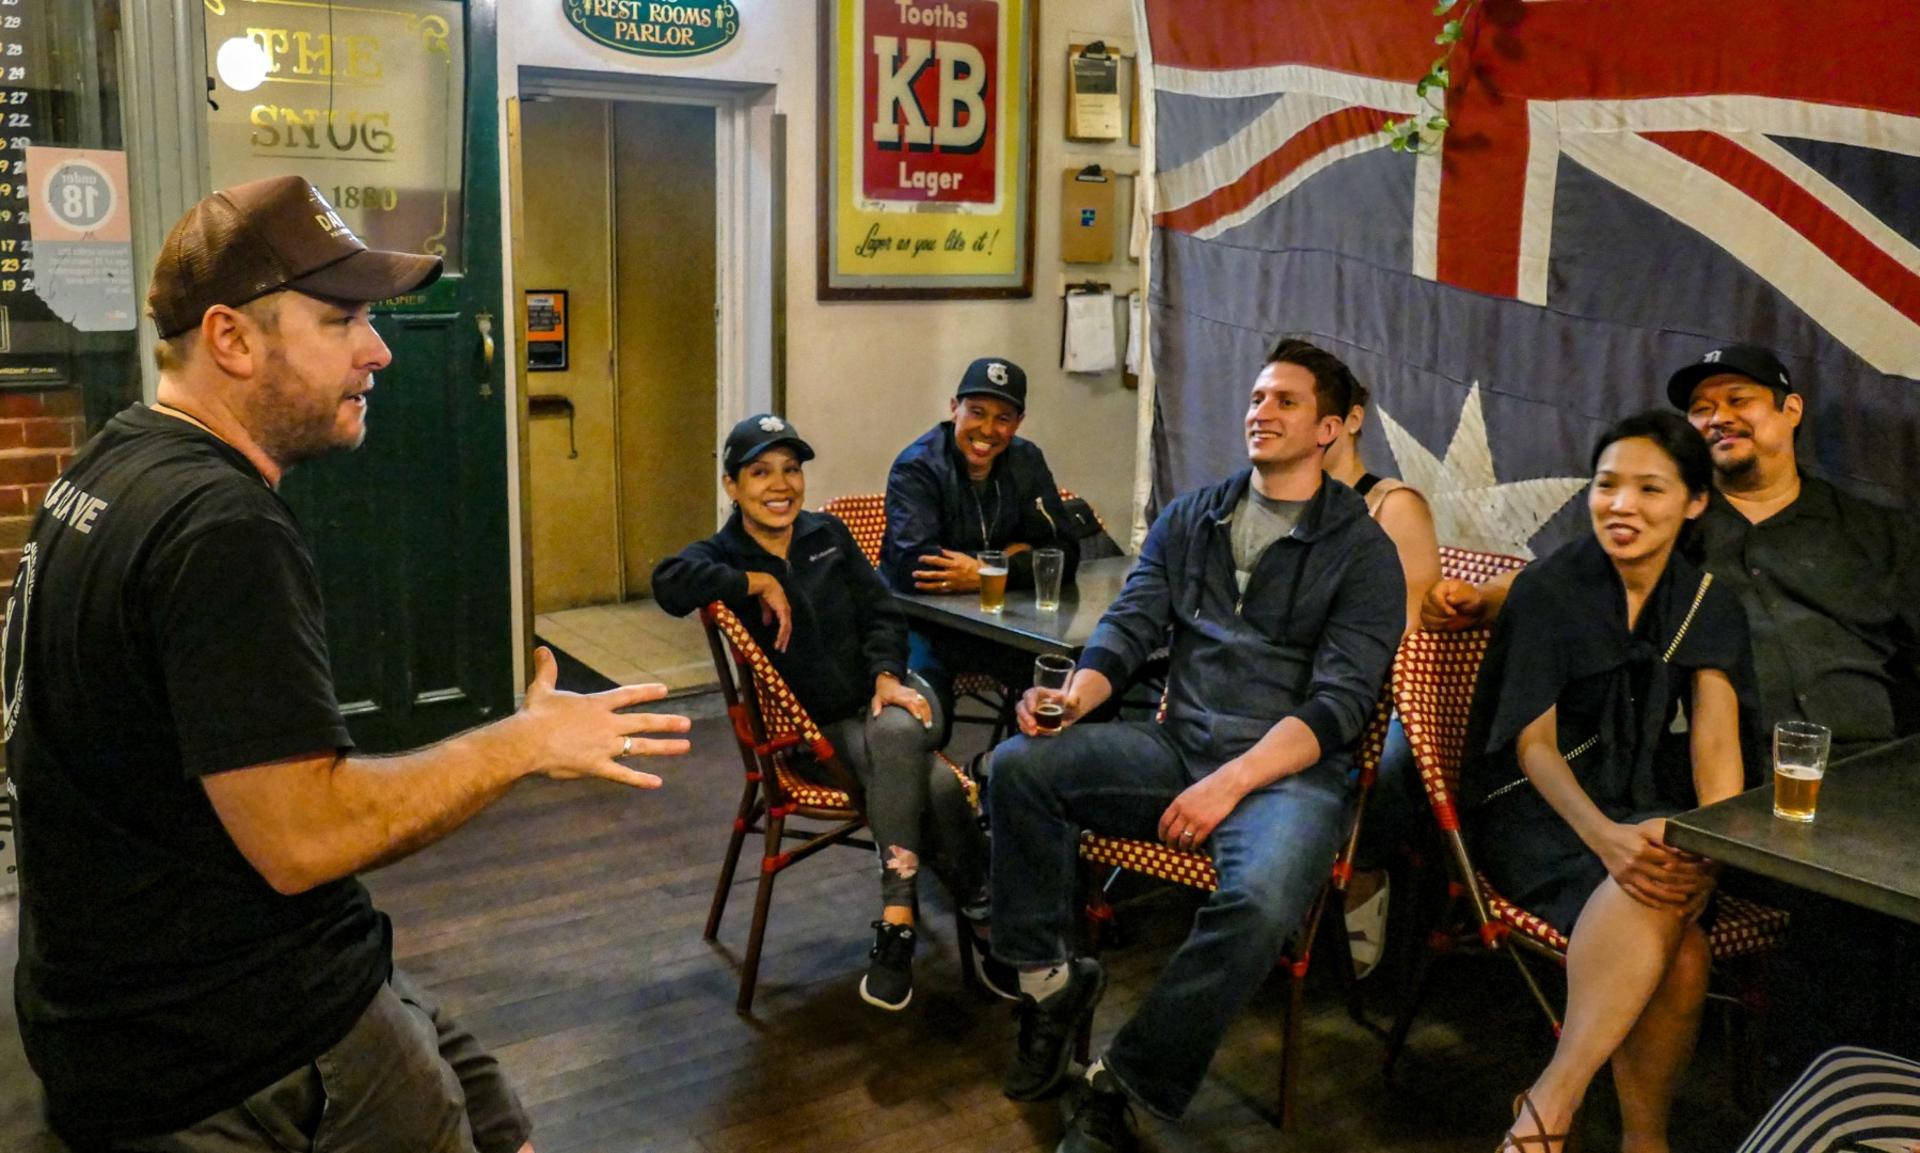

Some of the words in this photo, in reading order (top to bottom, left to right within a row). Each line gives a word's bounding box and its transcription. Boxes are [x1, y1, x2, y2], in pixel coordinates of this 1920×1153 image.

[594, 0, 642, 20] REST
[649, 3, 711, 28] ROOMS
[894, 0, 968, 29] Tooths
[615, 21, 695, 46] PARLOR
[246, 27, 384, 79] THE
[7, 66, 26, 80] 24
[9, 91, 29, 105] 27
[872, 35, 987, 152] KB
[8, 113, 31, 128] 22
[250, 104, 395, 154] SNUG
[10, 136, 31, 149] 20
[898, 161, 964, 197] Lager
[1, 239, 17, 253] 17
[854, 222, 892, 259] Lager
[911, 238, 937, 258] you
[943, 228, 966, 252] like
